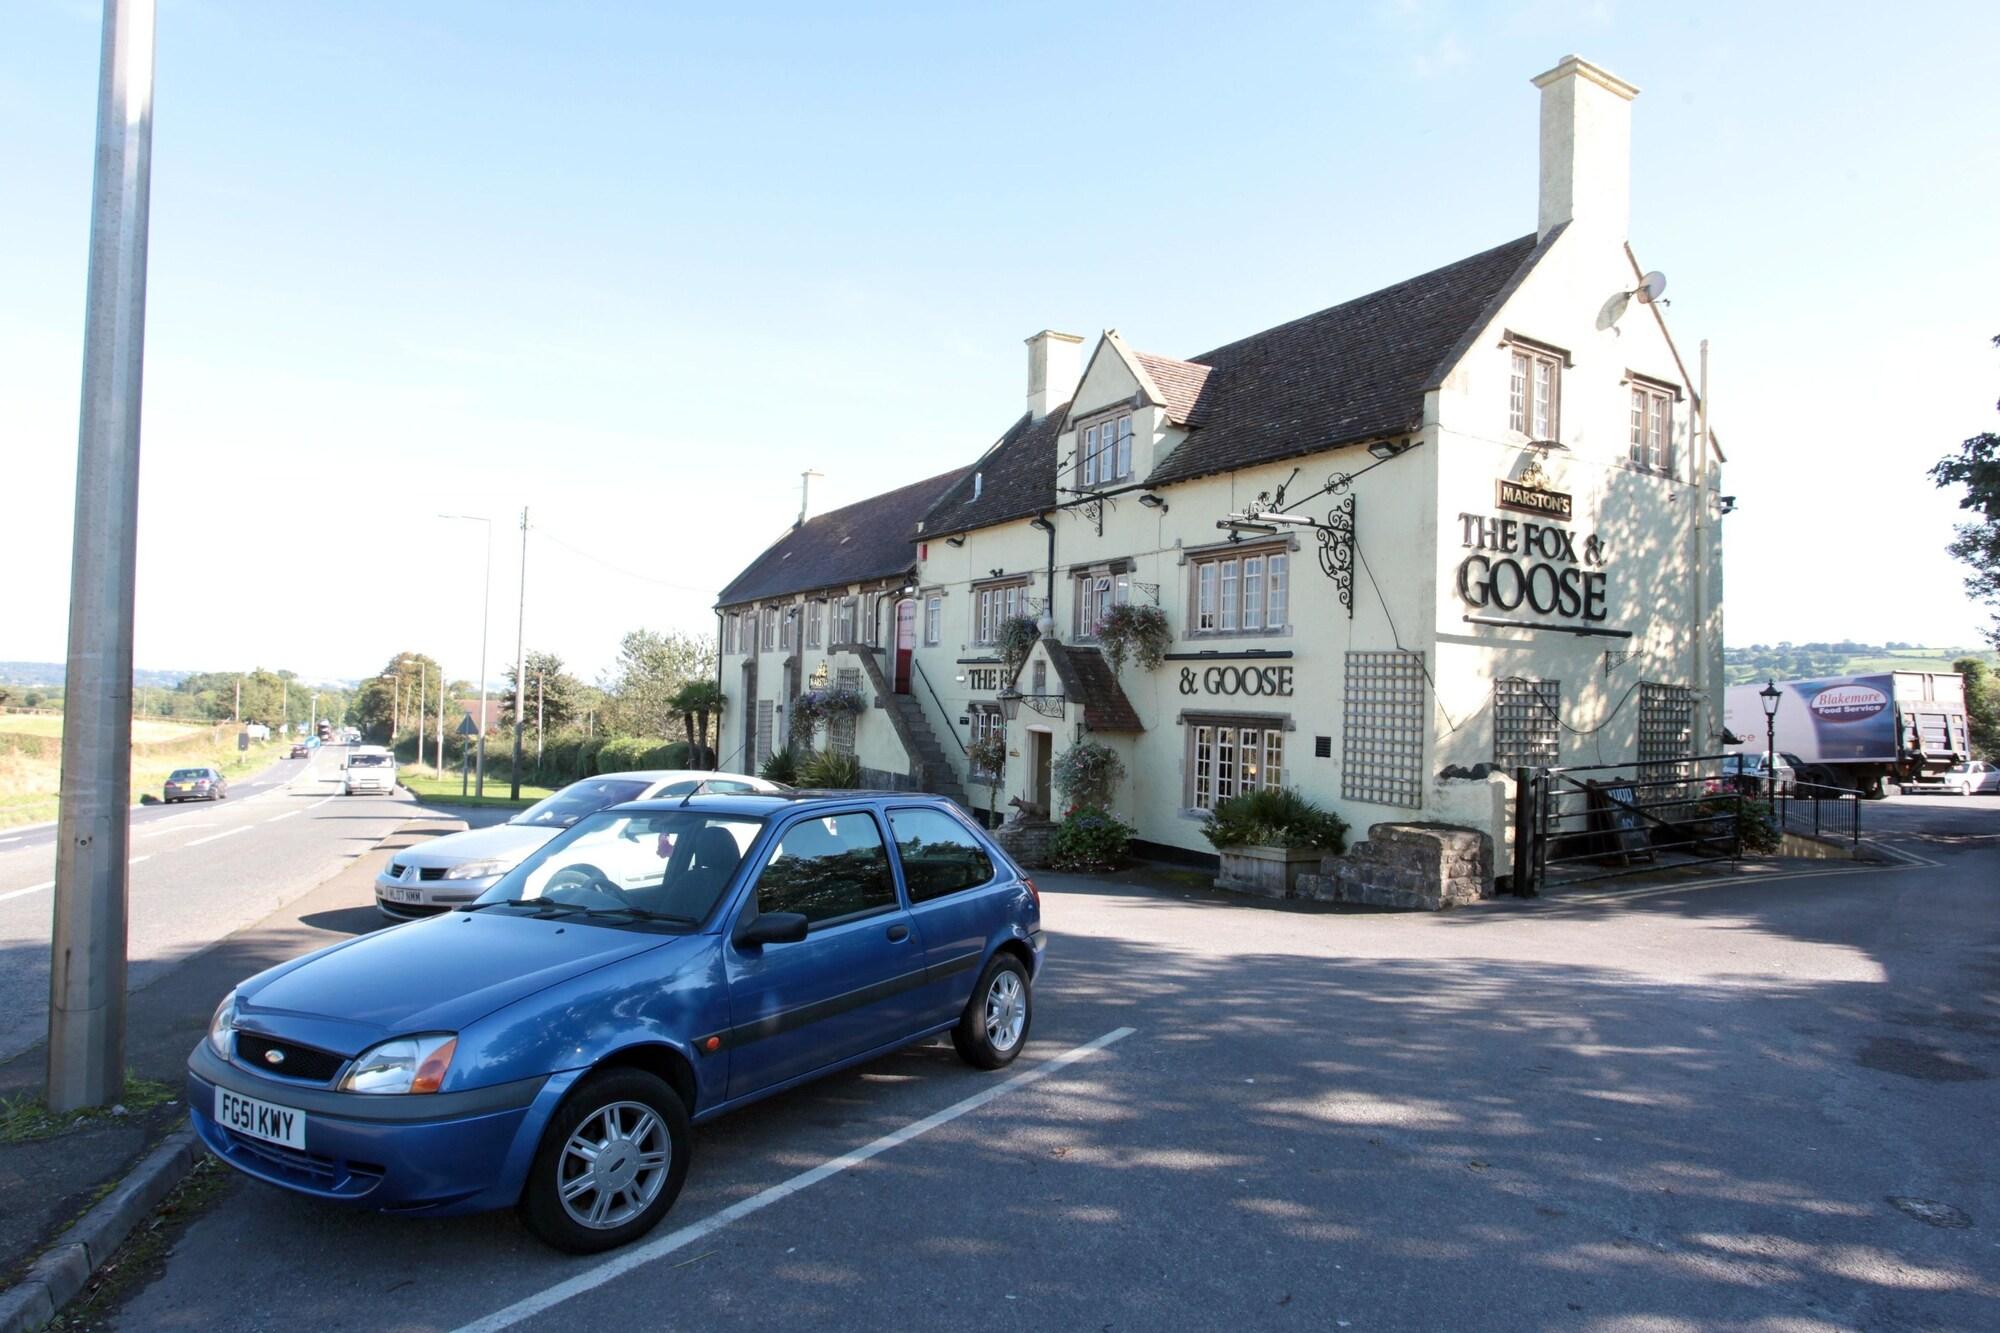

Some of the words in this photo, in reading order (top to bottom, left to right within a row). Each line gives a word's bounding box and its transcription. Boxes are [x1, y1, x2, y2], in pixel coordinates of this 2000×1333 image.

[1502, 486, 1570, 513] MARSTON'S
[1458, 512, 1517, 553] THE
[1523, 522, 1578, 564] FOX
[1584, 533, 1607, 567] &
[1457, 554, 1607, 621] GOOSE
[969, 669, 996, 690] THE
[1179, 666, 1198, 695] &
[1204, 666, 1294, 696] GOOSE
[1819, 692, 1880, 705] Blakemore
[1819, 706, 1842, 714] Food
[1844, 704, 1881, 713] Service
[223, 1093, 254, 1131] FG51
[259, 1105, 294, 1141] KWY
